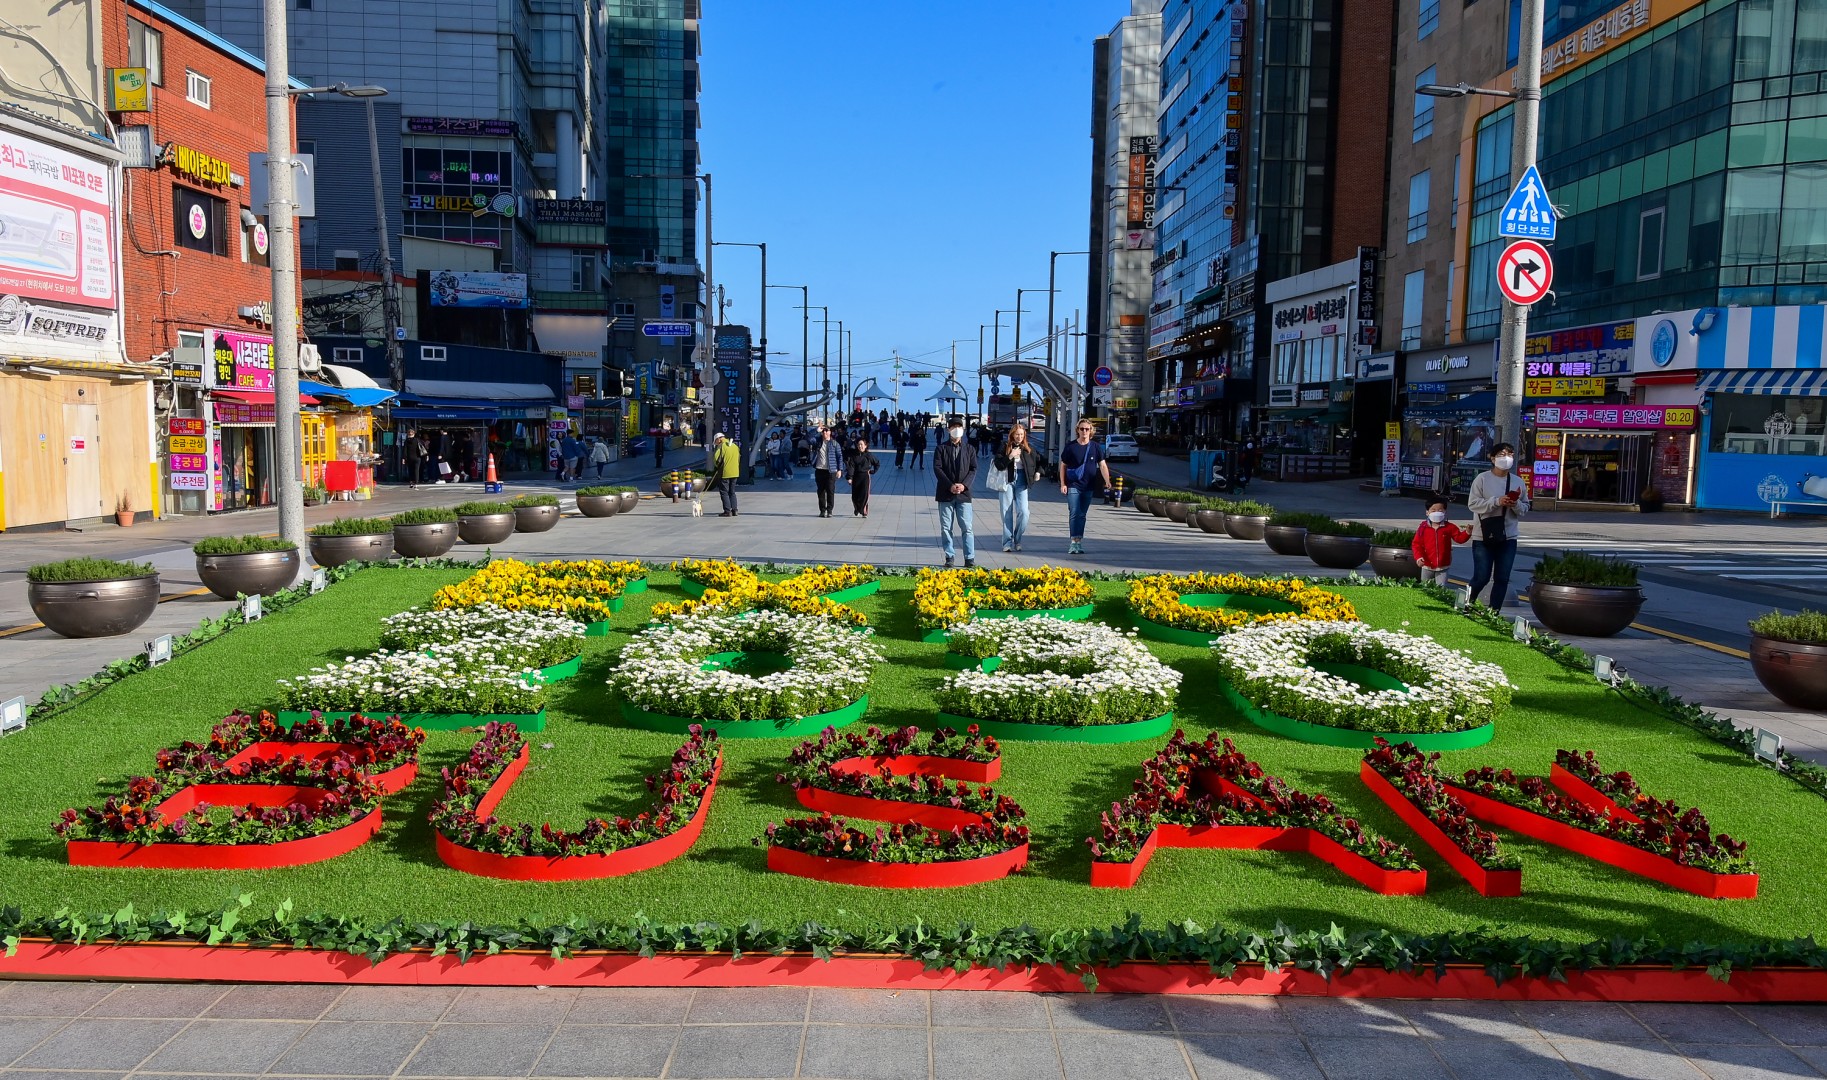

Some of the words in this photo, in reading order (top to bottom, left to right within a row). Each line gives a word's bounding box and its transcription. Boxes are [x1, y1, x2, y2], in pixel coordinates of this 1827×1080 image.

[1580, 0, 1650, 53] 해운대호텔
[178, 145, 231, 187] 베이컨꼬지
[87, 173, 103, 194] 오픈
[537, 200, 593, 212] 타이마사지
[1506, 222, 1551, 236] 횡단보도
[1361, 260, 1374, 318] 회전초밥
[32, 316, 107, 342] SOFTREE
[215, 349, 233, 365] 해운대
[1425, 359, 1442, 372] OLIVE
[1448, 355, 1469, 369] YOUNG
[218, 365, 231, 380] 명인
[1527, 380, 1552, 394] 황금
[1555, 379, 1592, 389] 조개구이
[1538, 408, 1559, 418] 한국
[1622, 408, 1662, 424] 할인샵
[172, 438, 204, 449] 손금·관상
[181, 457, 203, 468] 궁합
[1542, 464, 1557, 472] 사주
[173, 476, 205, 487] 사주전문
[50, 705, 1760, 900] BUSAN
